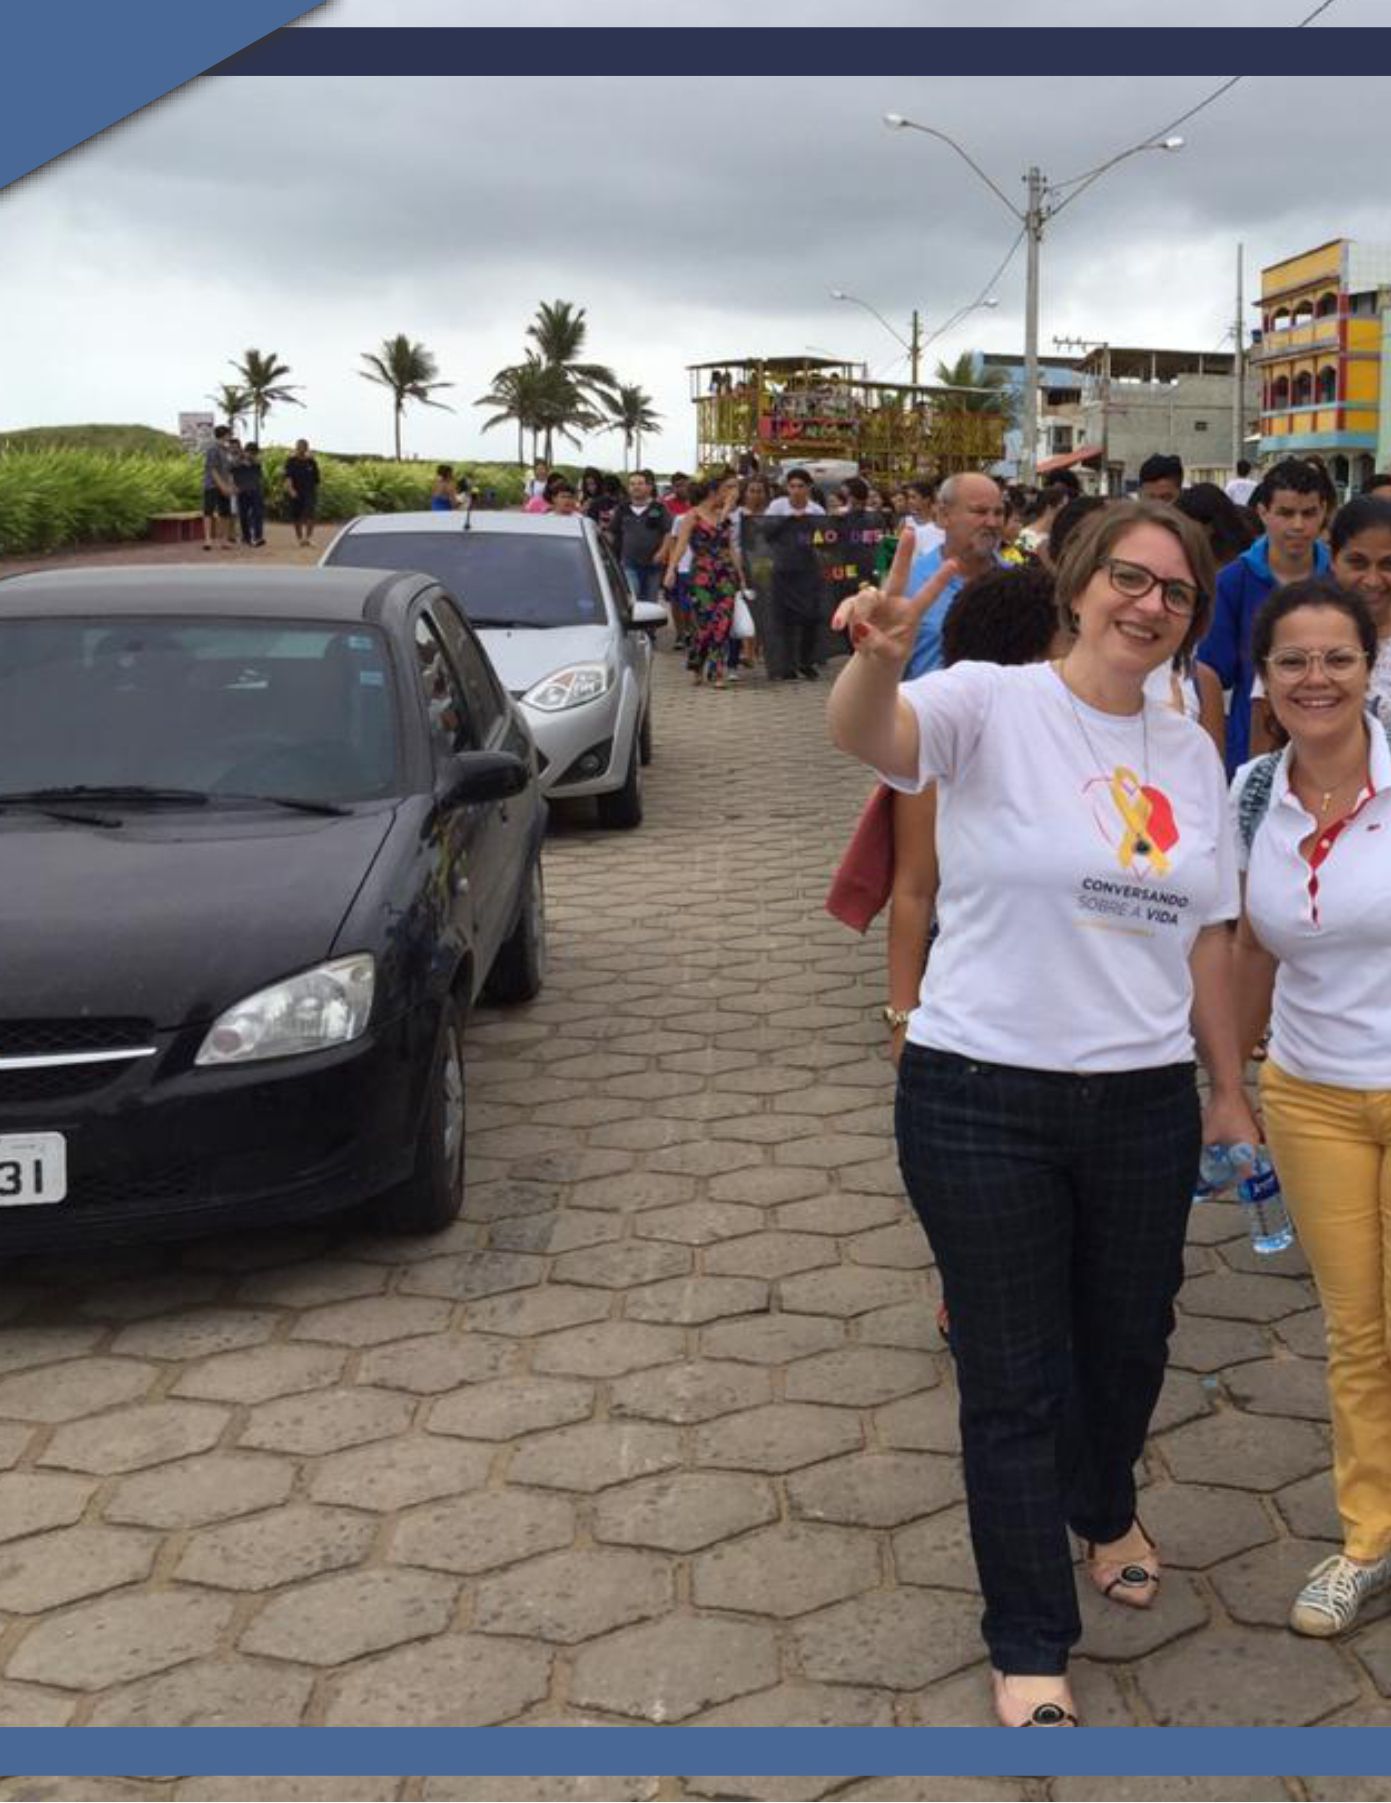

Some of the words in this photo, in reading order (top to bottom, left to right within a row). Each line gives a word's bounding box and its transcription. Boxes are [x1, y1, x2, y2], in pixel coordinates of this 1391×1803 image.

[1081, 878, 1190, 908] CONVERSANDO
[1078, 894, 1130, 917] SOBRE
[1131, 905, 1142, 919] A
[1146, 907, 1179, 926] VIDA
[0, 1159, 43, 1197] 31
